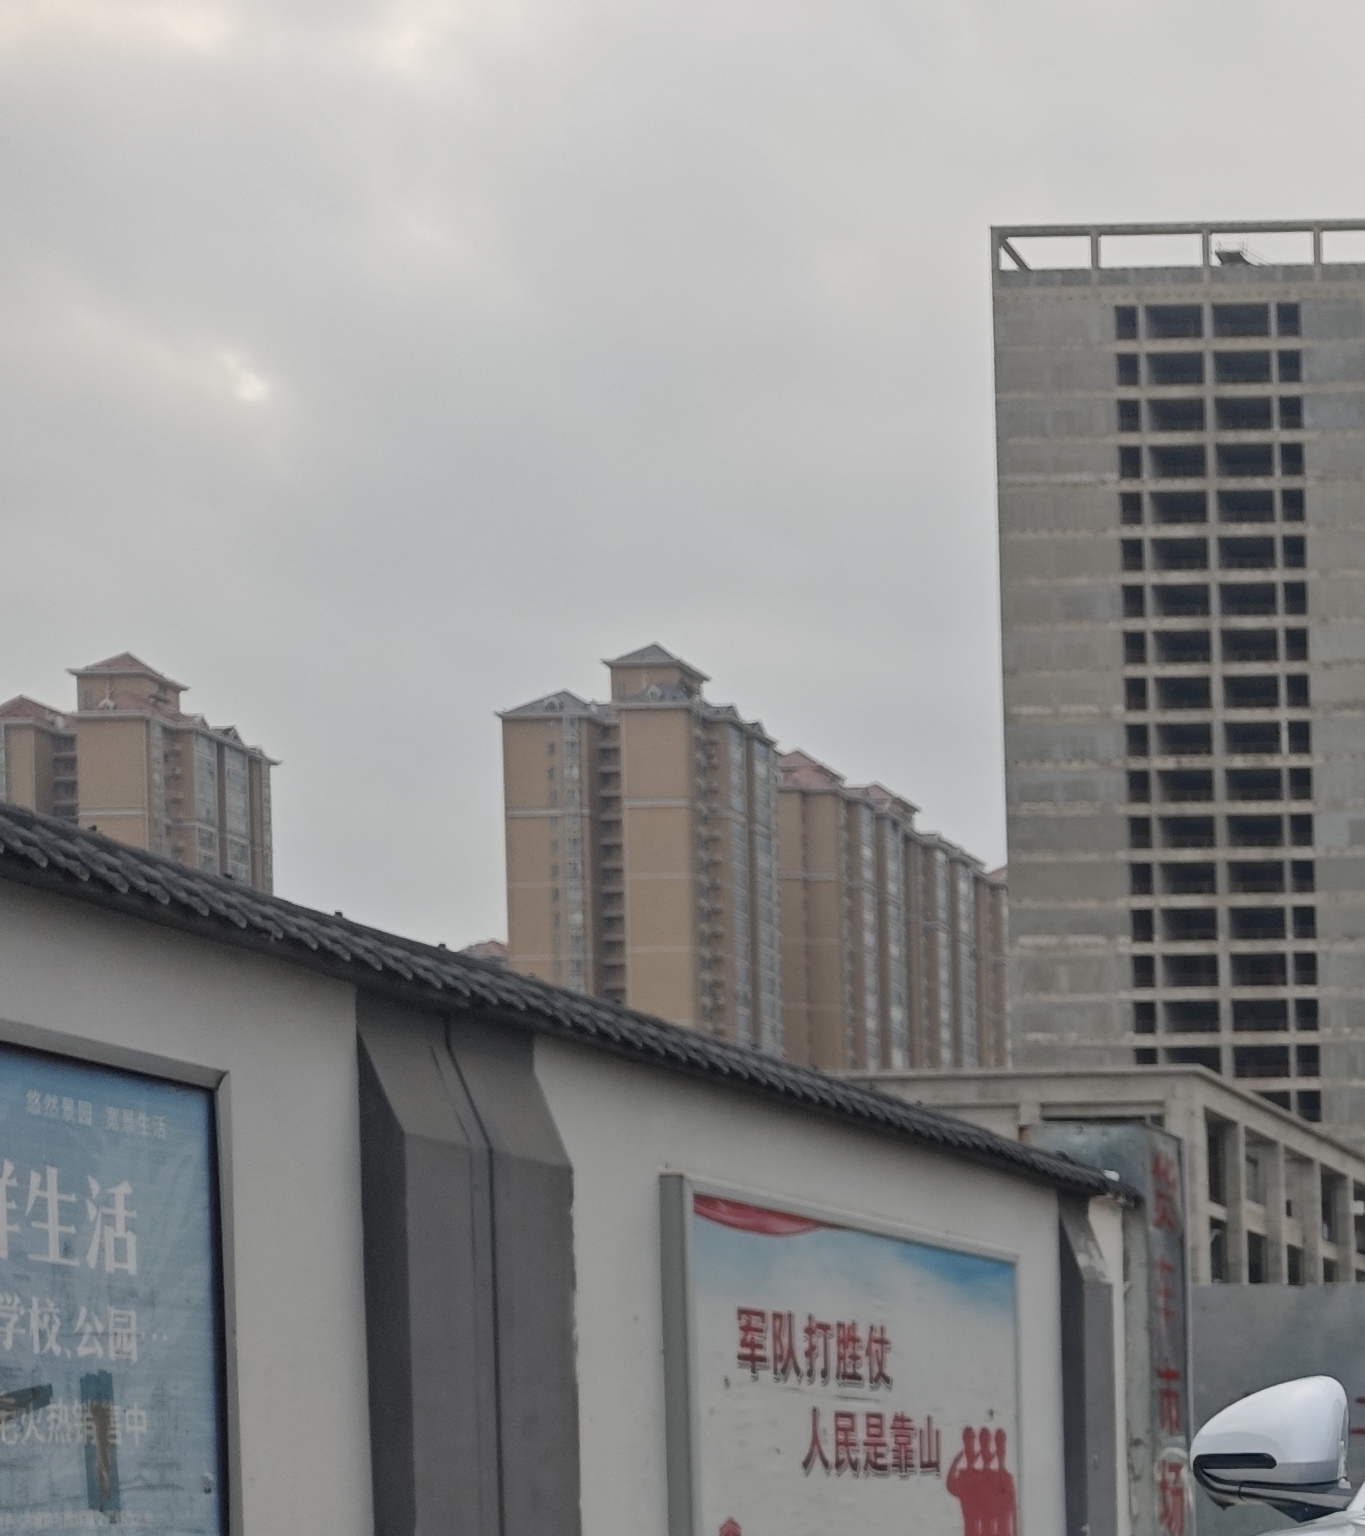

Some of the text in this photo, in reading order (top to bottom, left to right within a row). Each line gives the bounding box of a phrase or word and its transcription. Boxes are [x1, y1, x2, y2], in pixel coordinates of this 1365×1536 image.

[736, 1306, 893, 1391] 军队打胜仗
[801, 1405, 942, 1479] 人民是靠山
